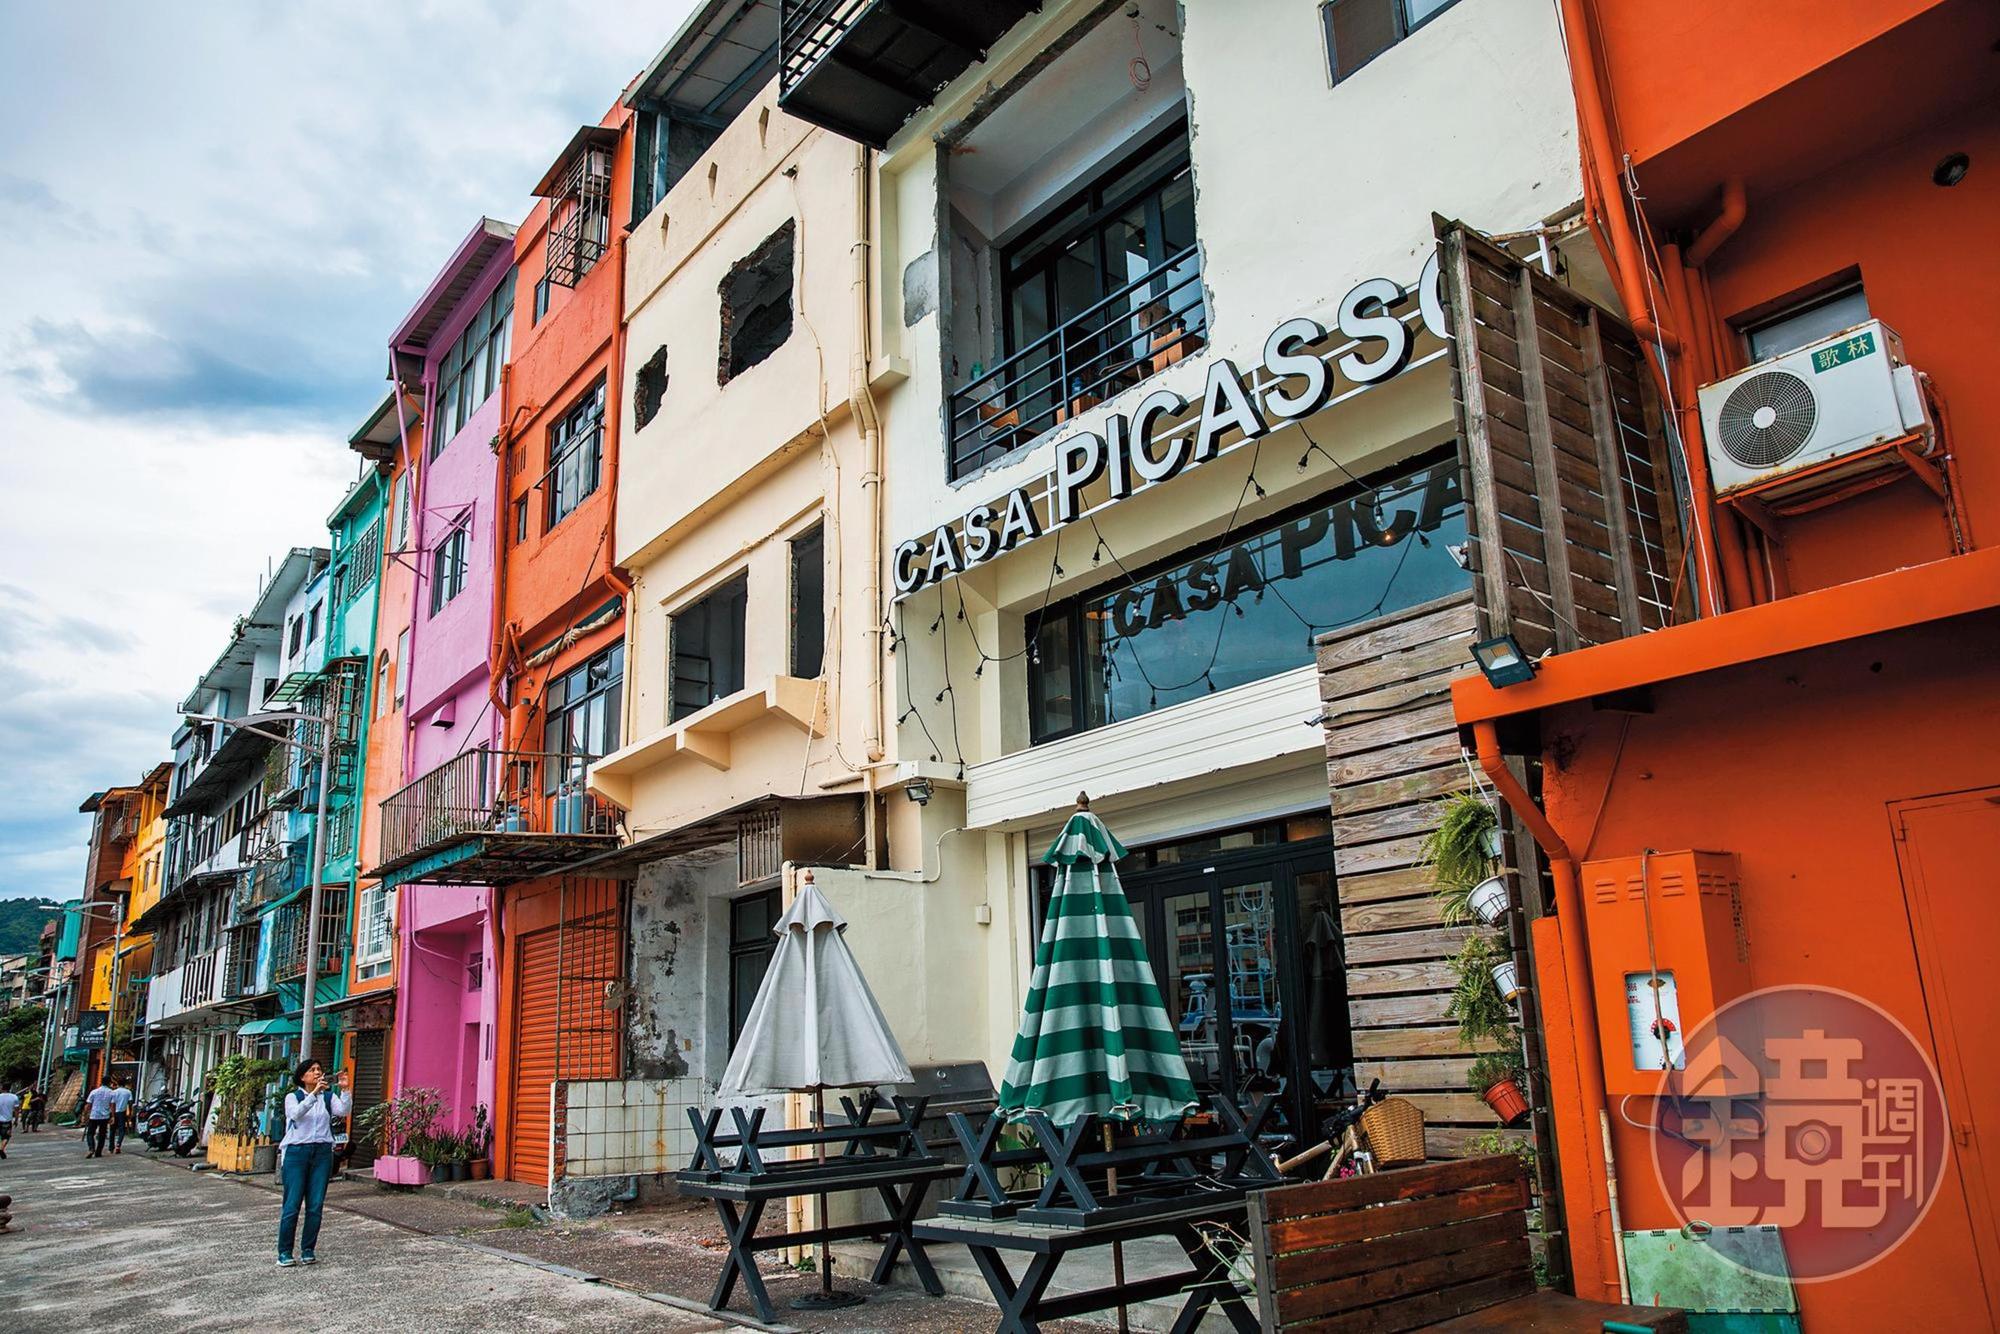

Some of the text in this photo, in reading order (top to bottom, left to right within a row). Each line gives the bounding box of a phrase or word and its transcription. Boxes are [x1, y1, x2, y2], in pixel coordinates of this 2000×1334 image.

[1818, 336, 1869, 369] 歌林
[893, 488, 1041, 593] CASA
[1112, 544, 1265, 637] CASA
